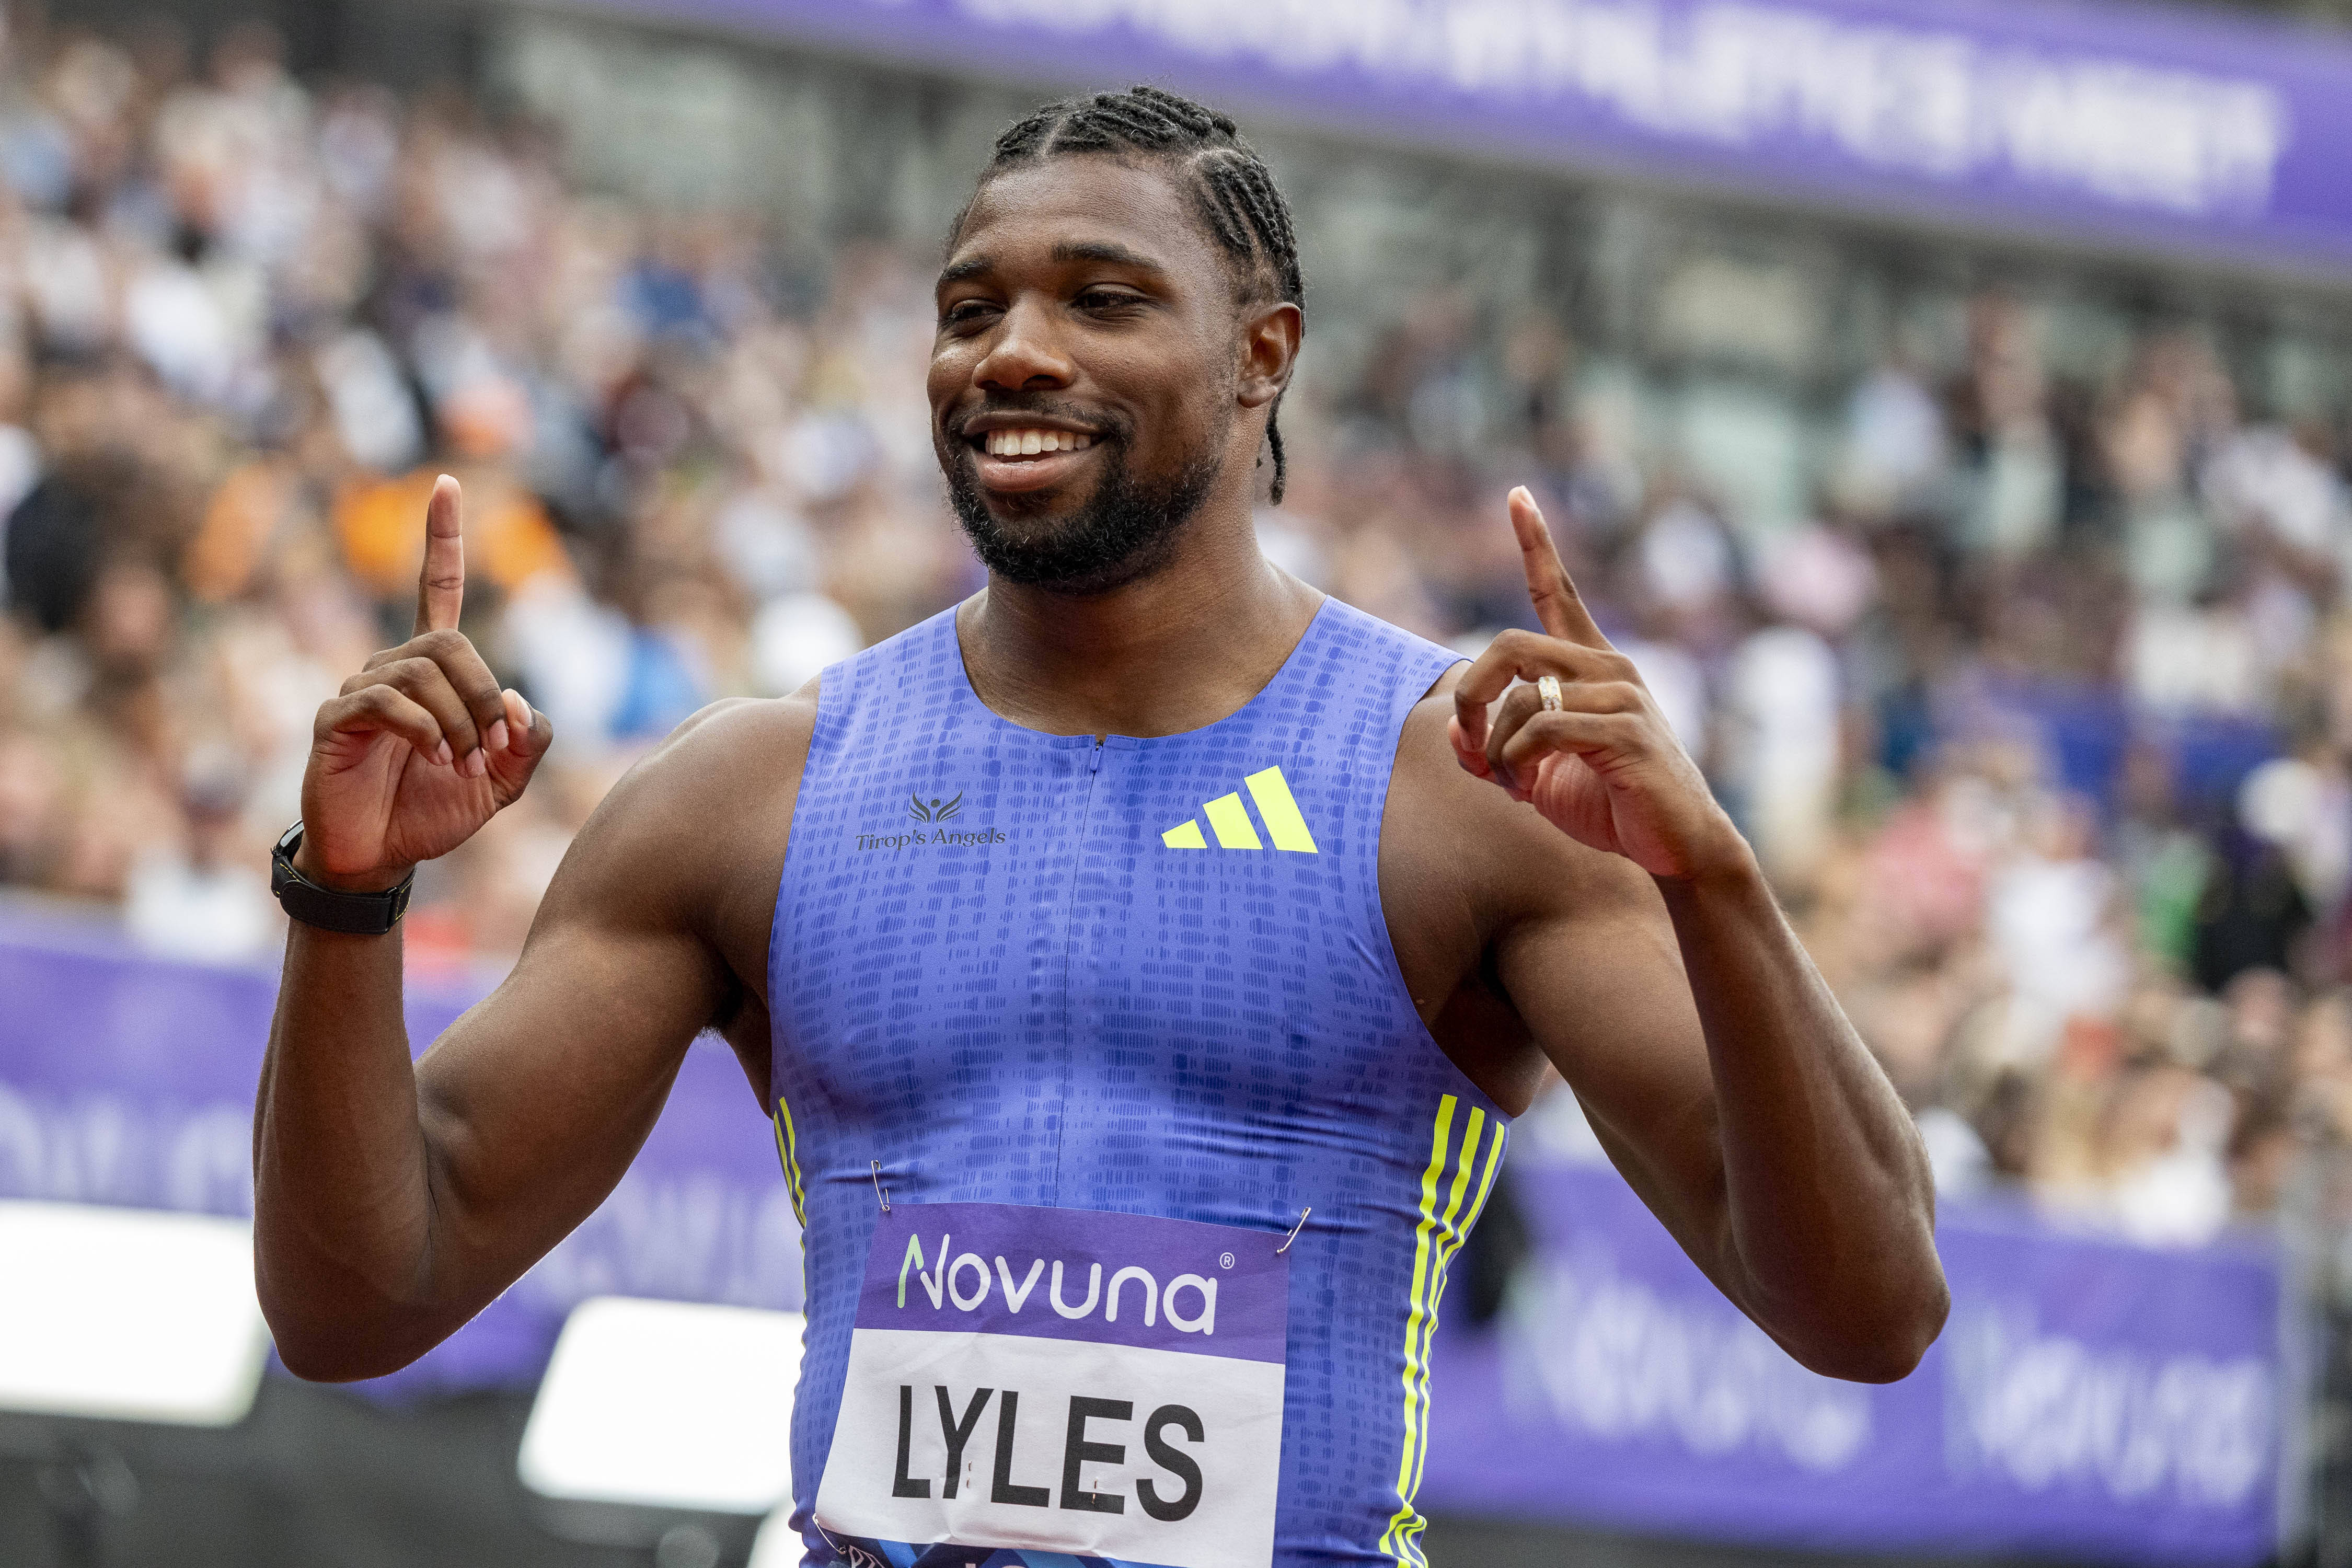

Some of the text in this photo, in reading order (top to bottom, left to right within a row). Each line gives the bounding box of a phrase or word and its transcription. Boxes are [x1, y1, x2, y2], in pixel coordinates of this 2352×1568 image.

[856, 828, 1006, 850] Tirop's Angels
[897, 1233, 1218, 1335] Novuna
[892, 1384, 1205, 1522] LYLES
